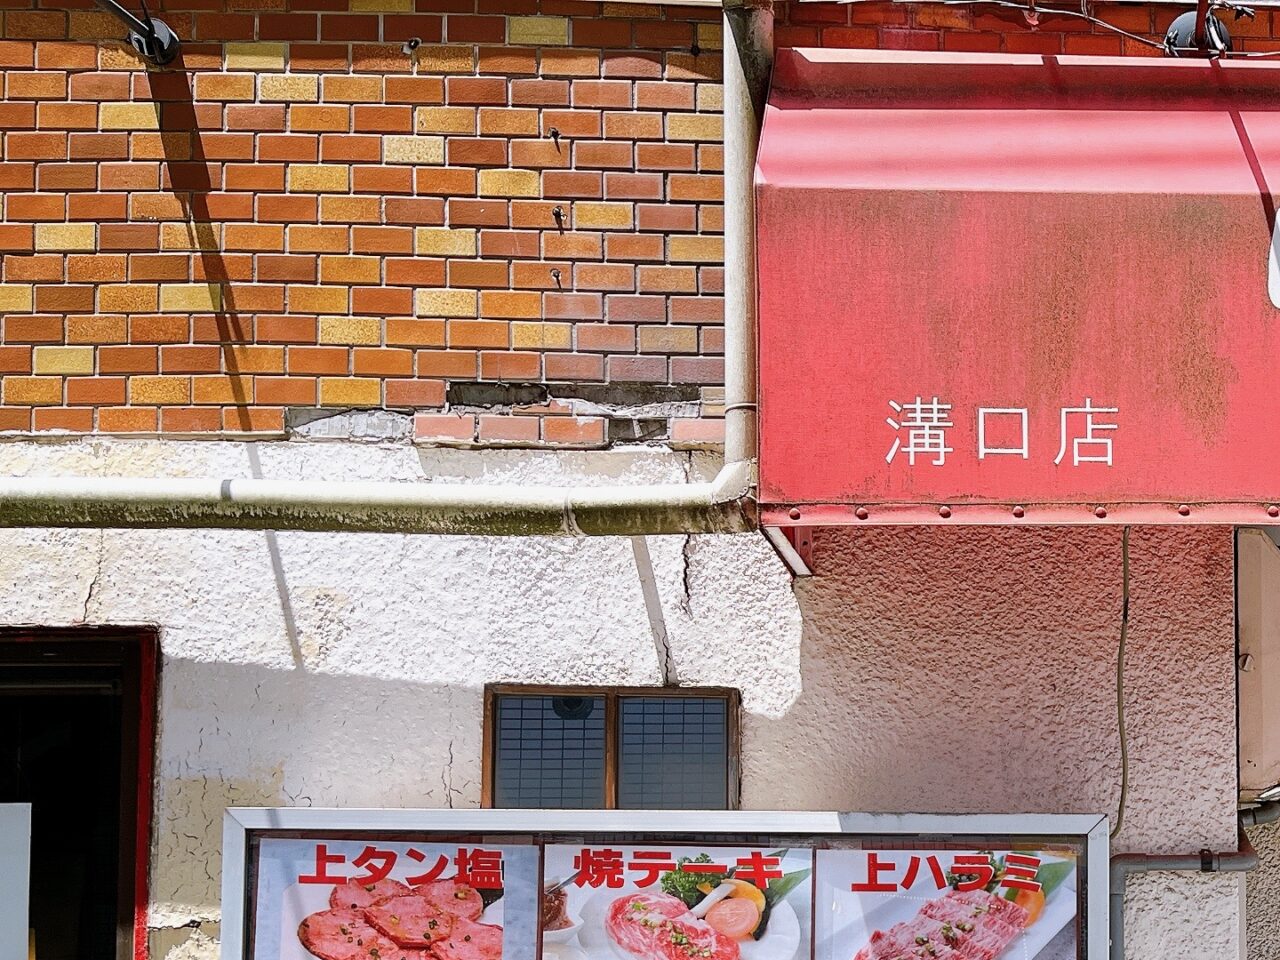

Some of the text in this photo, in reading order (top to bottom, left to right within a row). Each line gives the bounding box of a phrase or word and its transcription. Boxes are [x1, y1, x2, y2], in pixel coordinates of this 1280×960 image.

[885, 397, 1118, 468] 溝口店
[298, 845, 504, 890] 上タン塩
[573, 849, 783, 888] 焼テーキ
[851, 853, 1042, 892] 上ハラミ
